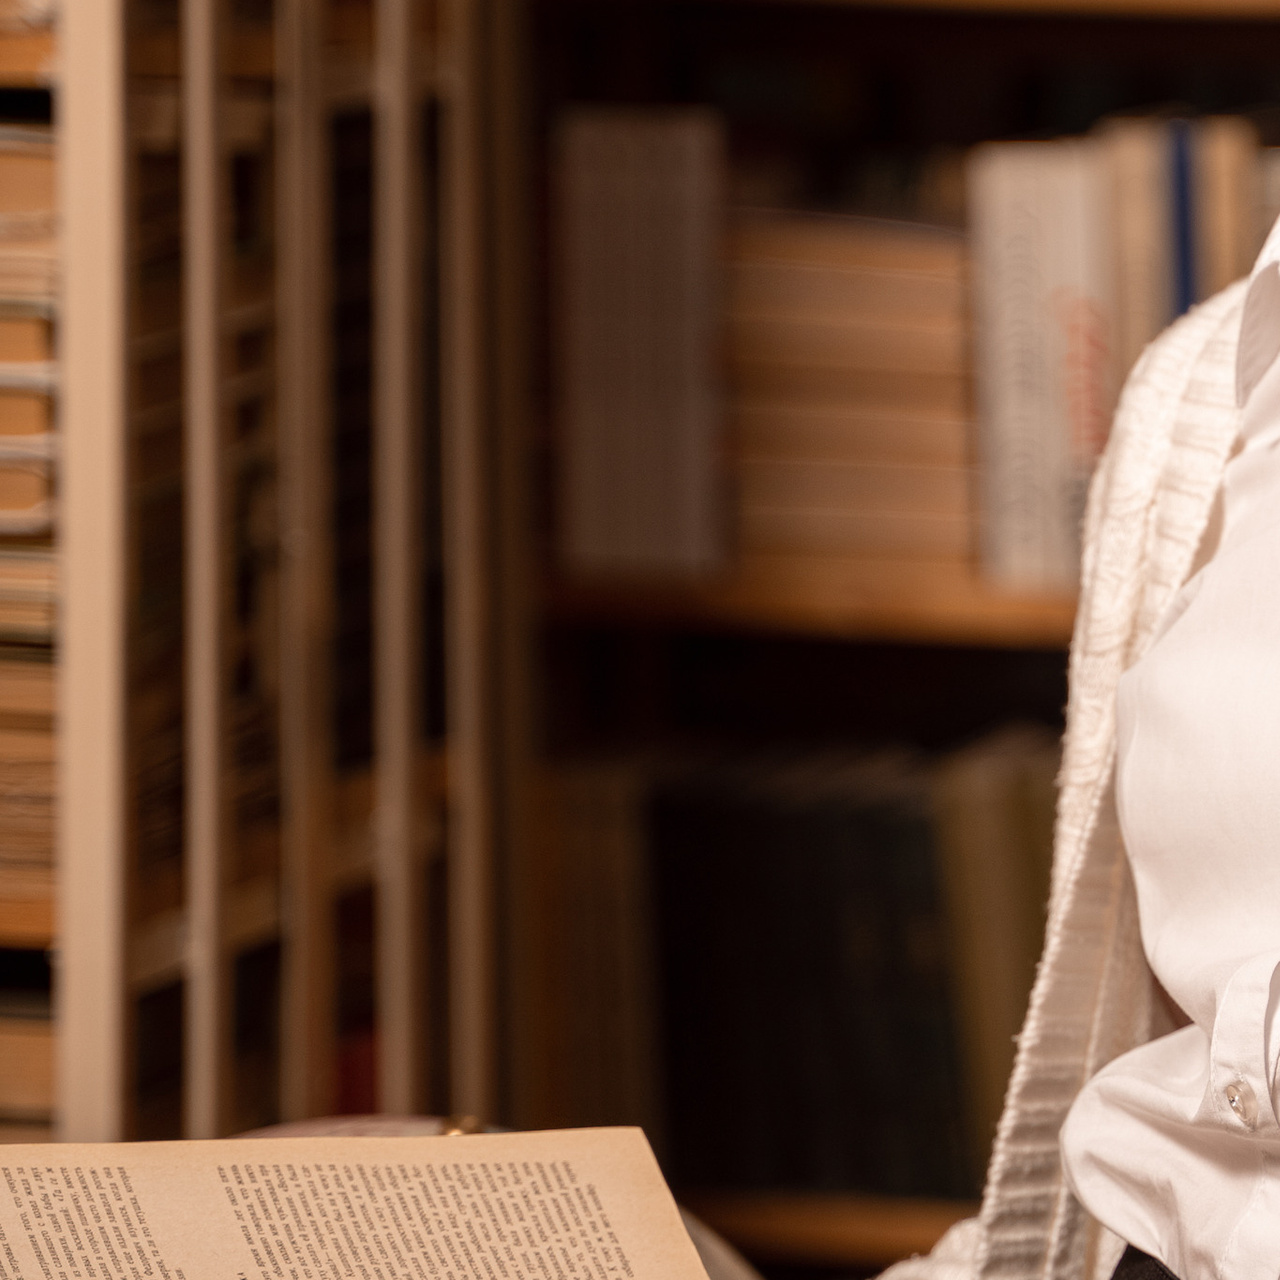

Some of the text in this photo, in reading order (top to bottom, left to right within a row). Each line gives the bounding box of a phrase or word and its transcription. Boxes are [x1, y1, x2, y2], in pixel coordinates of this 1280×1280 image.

[1, 1168, 18, 1193] очнулся
[30, 1167, 43, 1181] двух
[59, 1167, 74, 1188] вместе
[88, 1167, 103, 1189] рогож-
[102, 1167, 114, 1178] она
[116, 1166, 134, 1193] которая
[20, 1178, 33, 1196] жида
[50, 1189, 65, 1201] «Та
[73, 1166, 94, 1202] должность
[108, 1182, 123, 1201] когда
[12, 1196, 23, 1208] что
[28, 1200, 42, 1219] козел
[38, 1192, 54, 1210] бабы
[68, 1191, 89, 1226] пшеничку,
[97, 1192, 117, 1222] завидела
[128, 1194, 146, 1224] тетушка,
[18, 1210, 32, 1230] этого,
[46, 1213, 63, 1232] одной
[88, 1204, 102, 1223] часто
[117, 1204, 137, 1238] изумился,
[60, 1206, 85, 1251] восклицаний:
[111, 1225, 128, 1248] издали
[140, 1226, 152, 1237] это
[40, 1230, 63, 1267] слазившего
[57, 1235, 77, 1267] поварихи,
[83, 1228, 101, 1254] огороде
[96, 1225, 124, 1273] исправлявшим
[80, 1255, 96, 1277] первых
[122, 1251, 135, 1264] еще
[130, 1241, 155, 1276] Федорович
